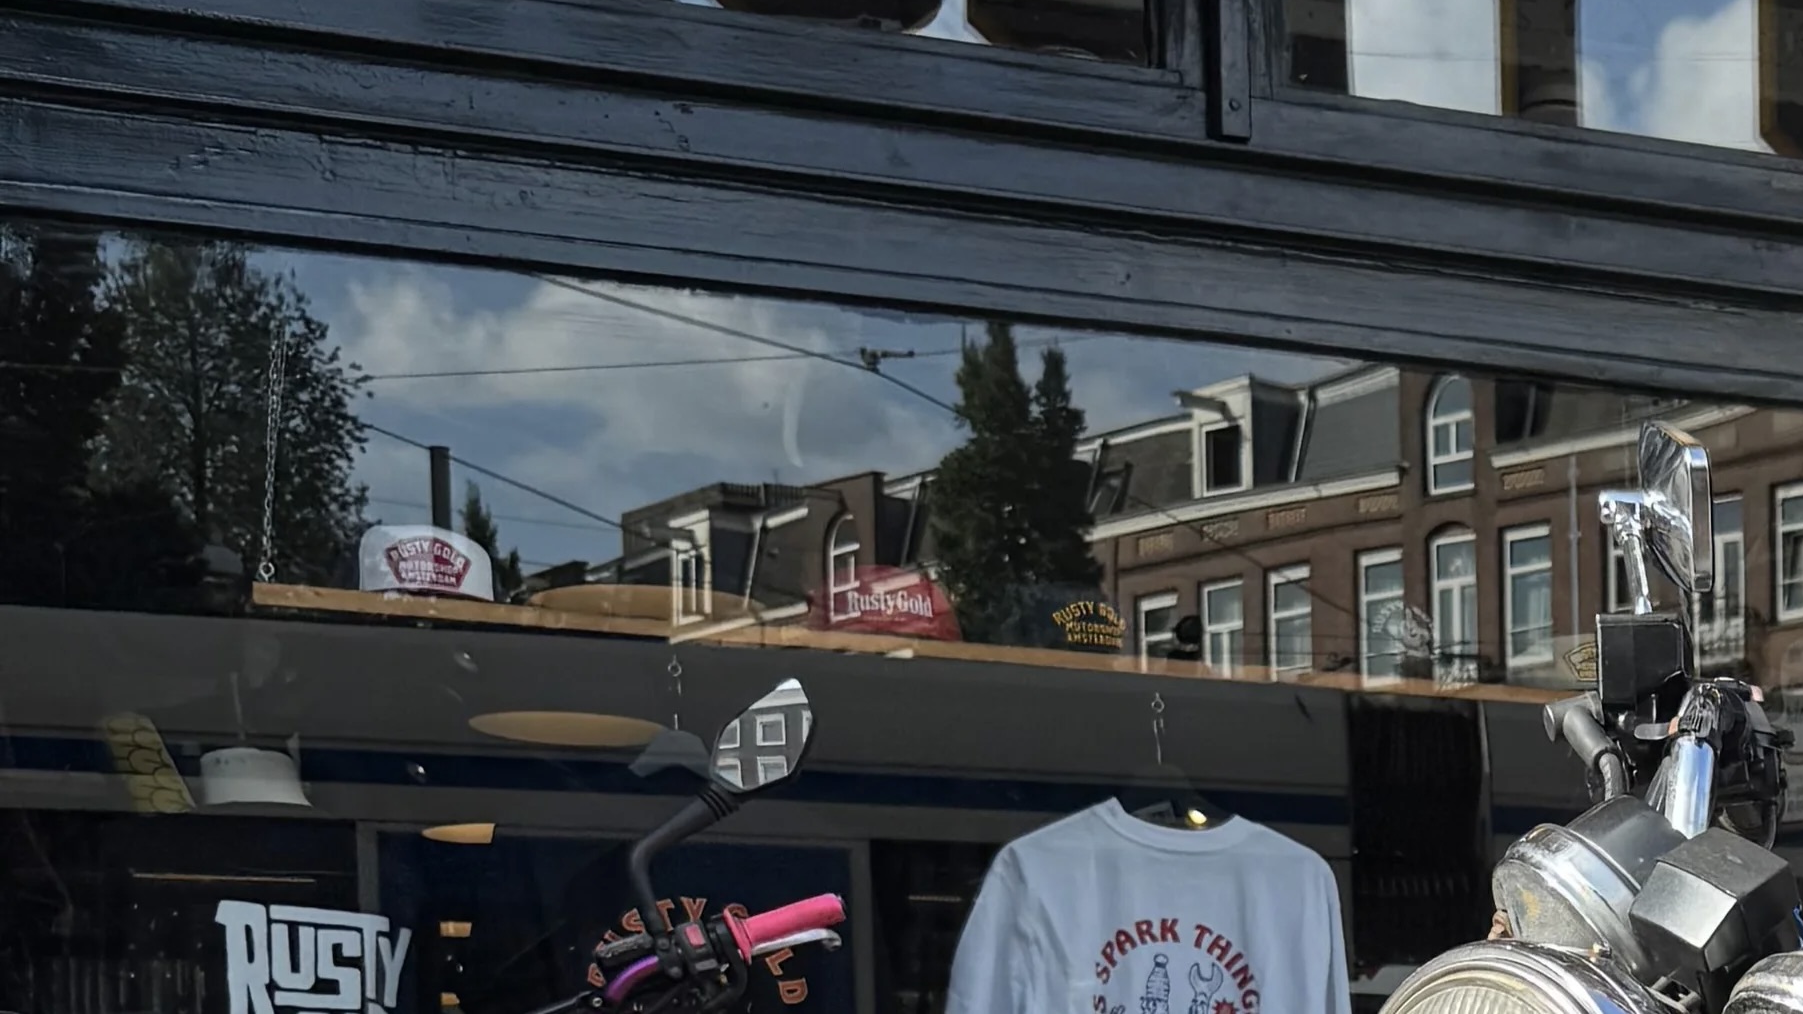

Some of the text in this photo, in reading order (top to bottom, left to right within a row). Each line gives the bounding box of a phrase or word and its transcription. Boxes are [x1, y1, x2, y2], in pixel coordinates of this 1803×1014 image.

[386, 539, 466, 570] RUSTY GOLD
[1052, 601, 1094, 626] RUSTY
[215, 900, 413, 1014] RUSTY
[1095, 918, 1262, 1014] SPARK THING
